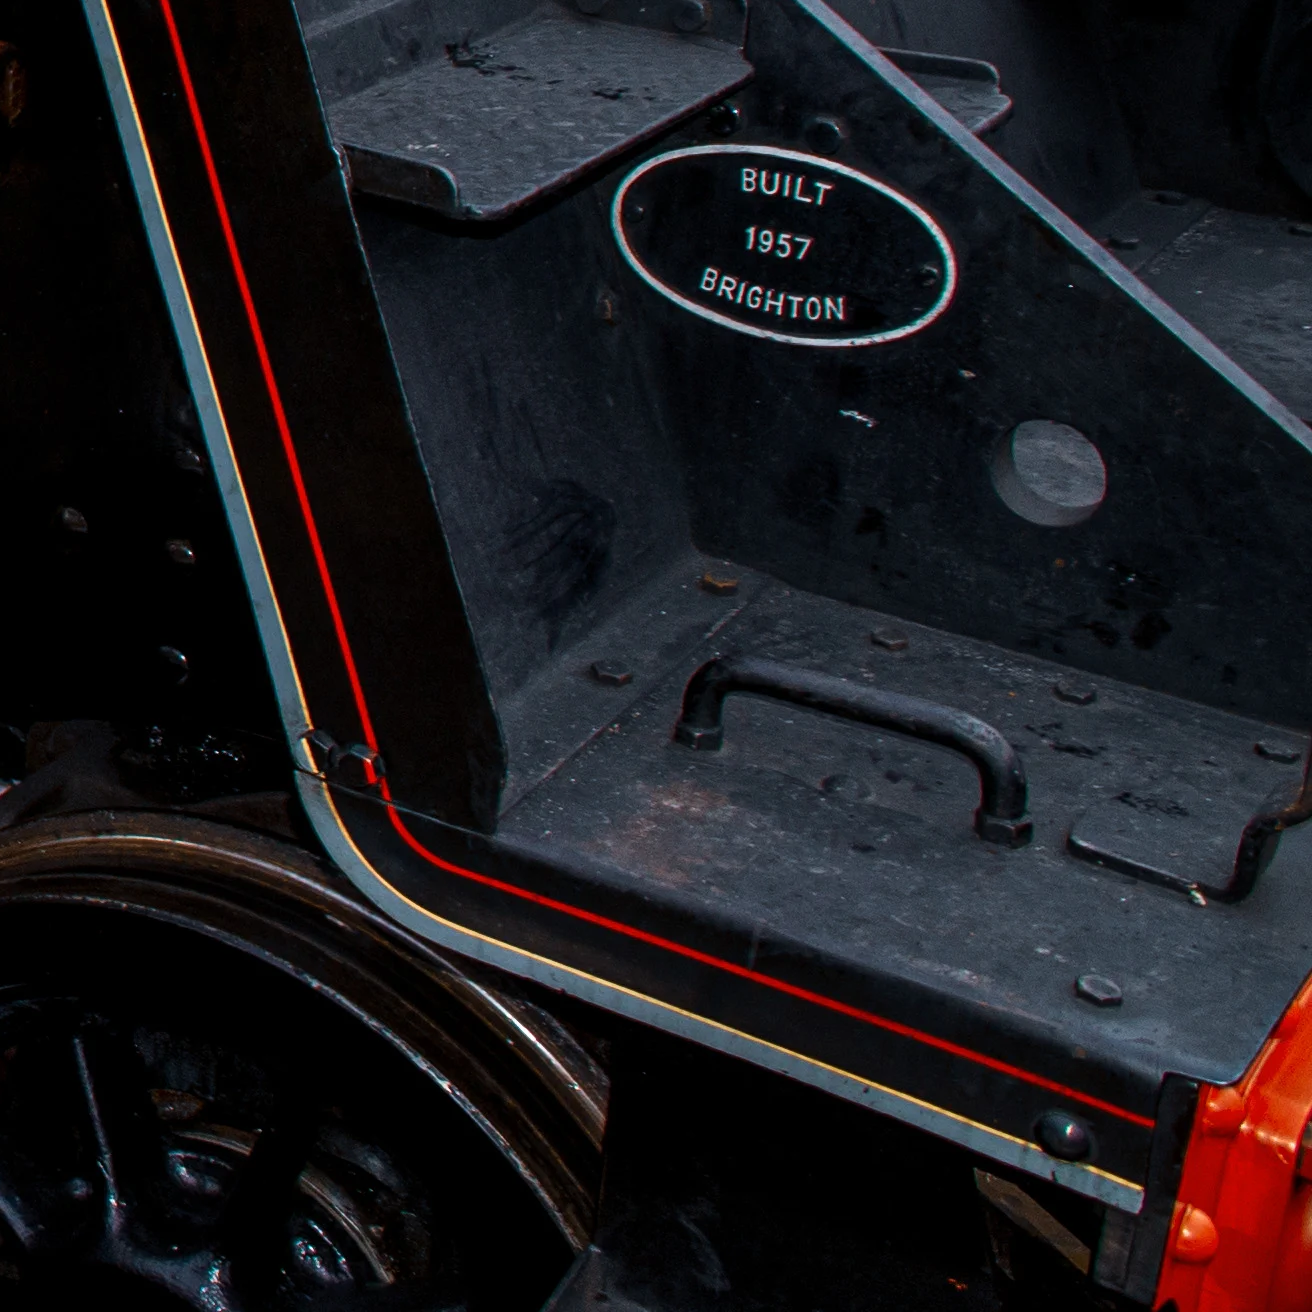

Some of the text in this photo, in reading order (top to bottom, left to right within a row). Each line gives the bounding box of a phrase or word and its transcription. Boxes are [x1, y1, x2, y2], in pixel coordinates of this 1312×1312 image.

[740, 168, 834, 206] BUILT
[745, 226, 814, 261] 1957
[699, 266, 847, 321] BRIGHTON
